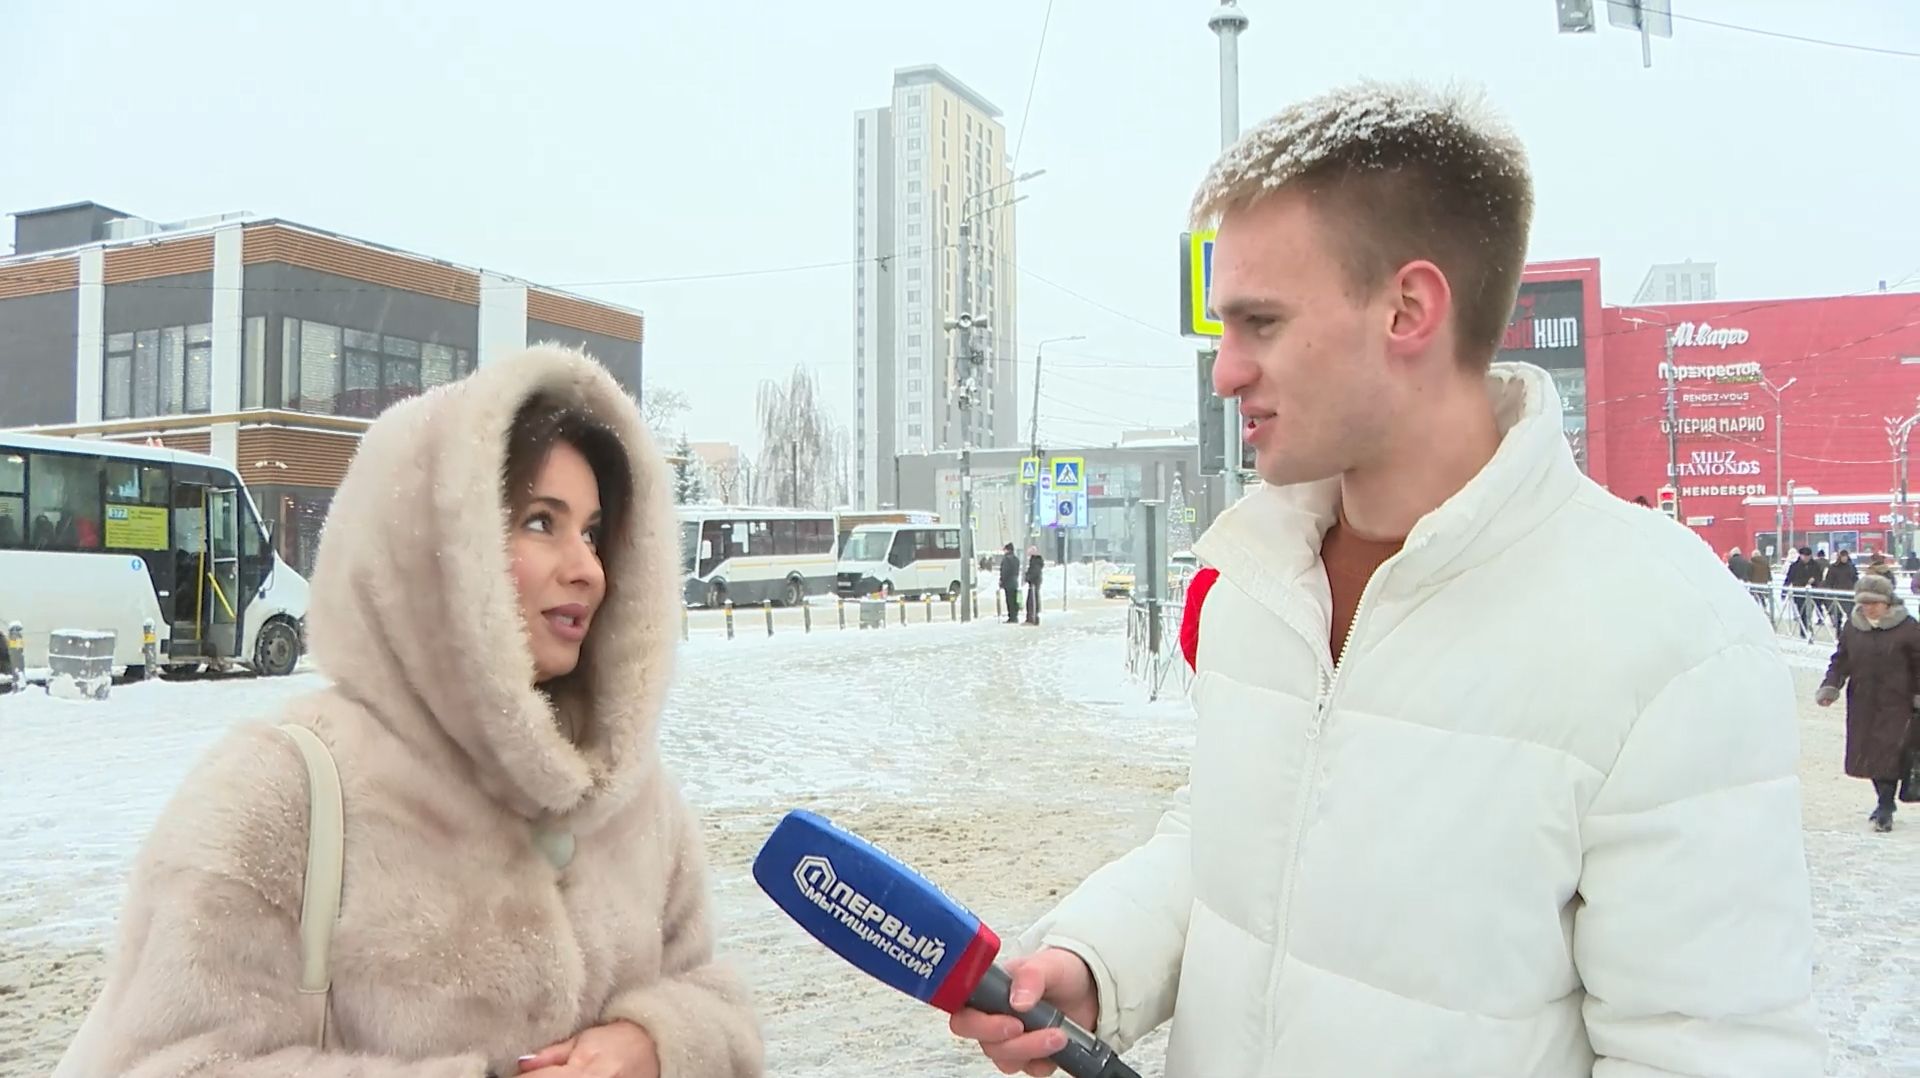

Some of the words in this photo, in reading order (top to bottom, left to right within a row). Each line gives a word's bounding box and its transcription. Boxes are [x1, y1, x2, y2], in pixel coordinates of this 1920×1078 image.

[1682, 392, 1750, 403] RENDEZ-VOUS
[1720, 415, 1765, 433] МАРИО
[1691, 450, 1737, 464] MIUZ
[1682, 484, 1766, 497] HENDERSON
[831, 881, 946, 966] ПЕРВЫЙ
[804, 886, 934, 979] МЫТИЩИНСКИЙ
